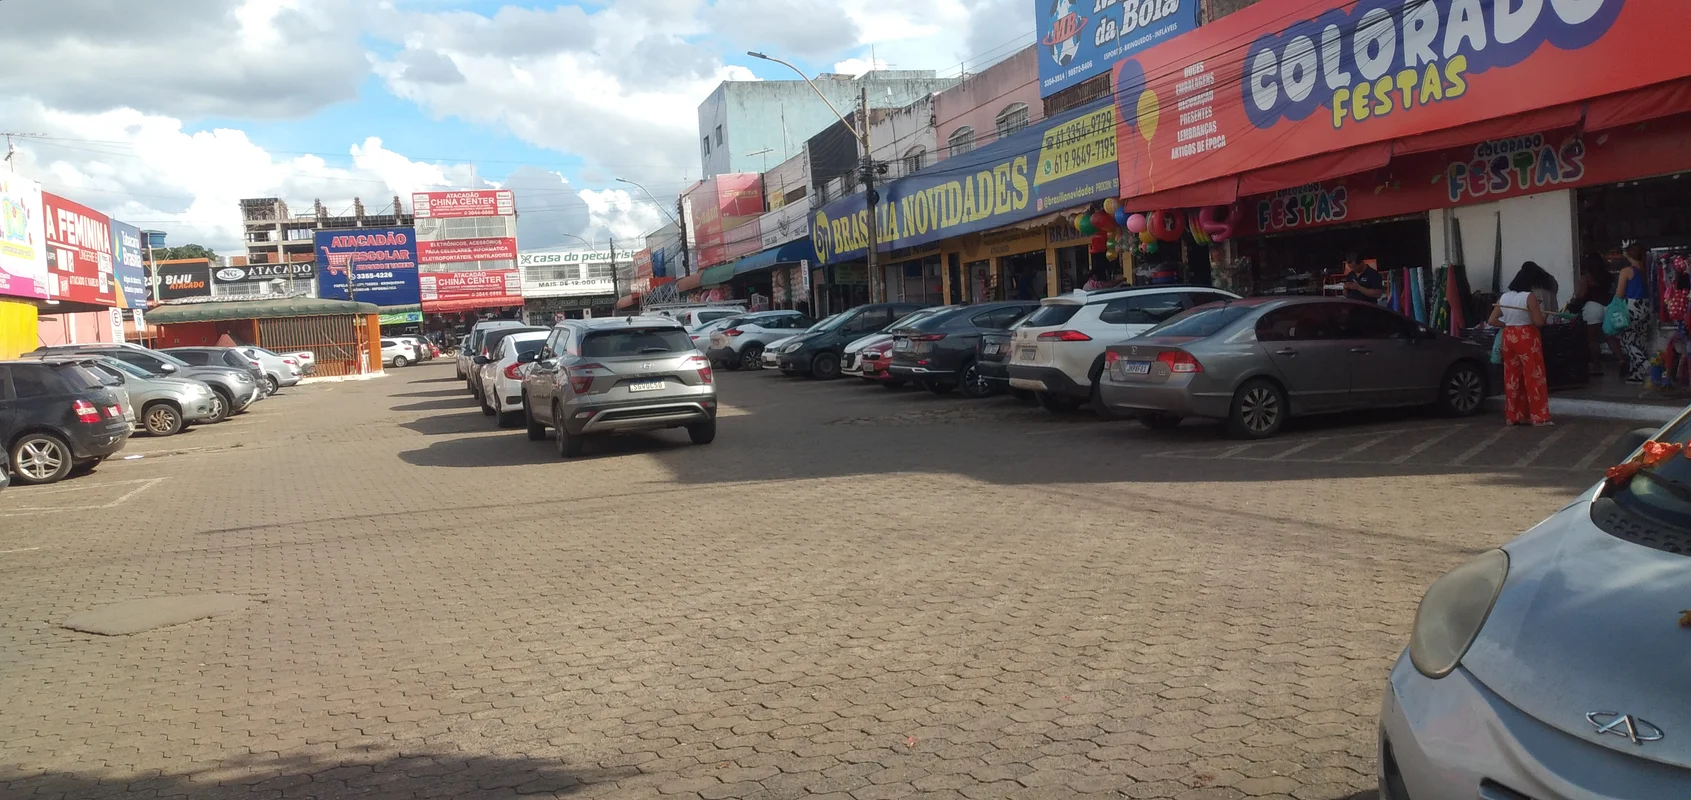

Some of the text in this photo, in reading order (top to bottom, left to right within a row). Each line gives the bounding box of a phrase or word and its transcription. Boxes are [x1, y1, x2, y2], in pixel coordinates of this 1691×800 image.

[1052, 12, 1076, 43] MB
[1095, 0, 1179, 46] da Bola
[1103, 22, 1178, 60] ESPORTS BRINQUEDOS INFLÁVEIS
[1183, 61, 1204, 78] DOCES
[1175, 72, 1215, 96] EMBALAGENS
[1332, 54, 1467, 128] FESTAS
[1180, 106, 1213, 126] PRESENTES
[1056, 110, 1112, 149] 61 3354-9729
[1177, 120, 1217, 142] LEMBRANÇAS
[1054, 136, 1115, 174] 61 9 9649-7195
[1171, 136, 1227, 160] ARTIGOS DE ÉPOCA
[1476, 133, 1544, 158] COLORADO
[1448, 140, 1585, 202] FESTAS
[430, 198, 458, 206] CHINA
[459, 197, 495, 205] CENTER
[831, 156, 1029, 254] BRASLIA NOVIDADES
[1257, 187, 1348, 231] FESTAS
[46, 204, 111, 254] A FEMININA
[331, 231, 406, 248] ATACADÃO
[352, 249, 409, 261] ESCOLAR
[533, 254, 562, 263] casa
[564, 252, 579, 262] do
[582, 249, 634, 263] pecuarist
[165, 274, 192, 285] BIJU
[248, 264, 311, 276] ATACADO
[438, 278, 465, 286] CHINA
[467, 276, 502, 284] CENTER
[169, 281, 204, 290] ATACADO
[113, 313, 119, 321] E
